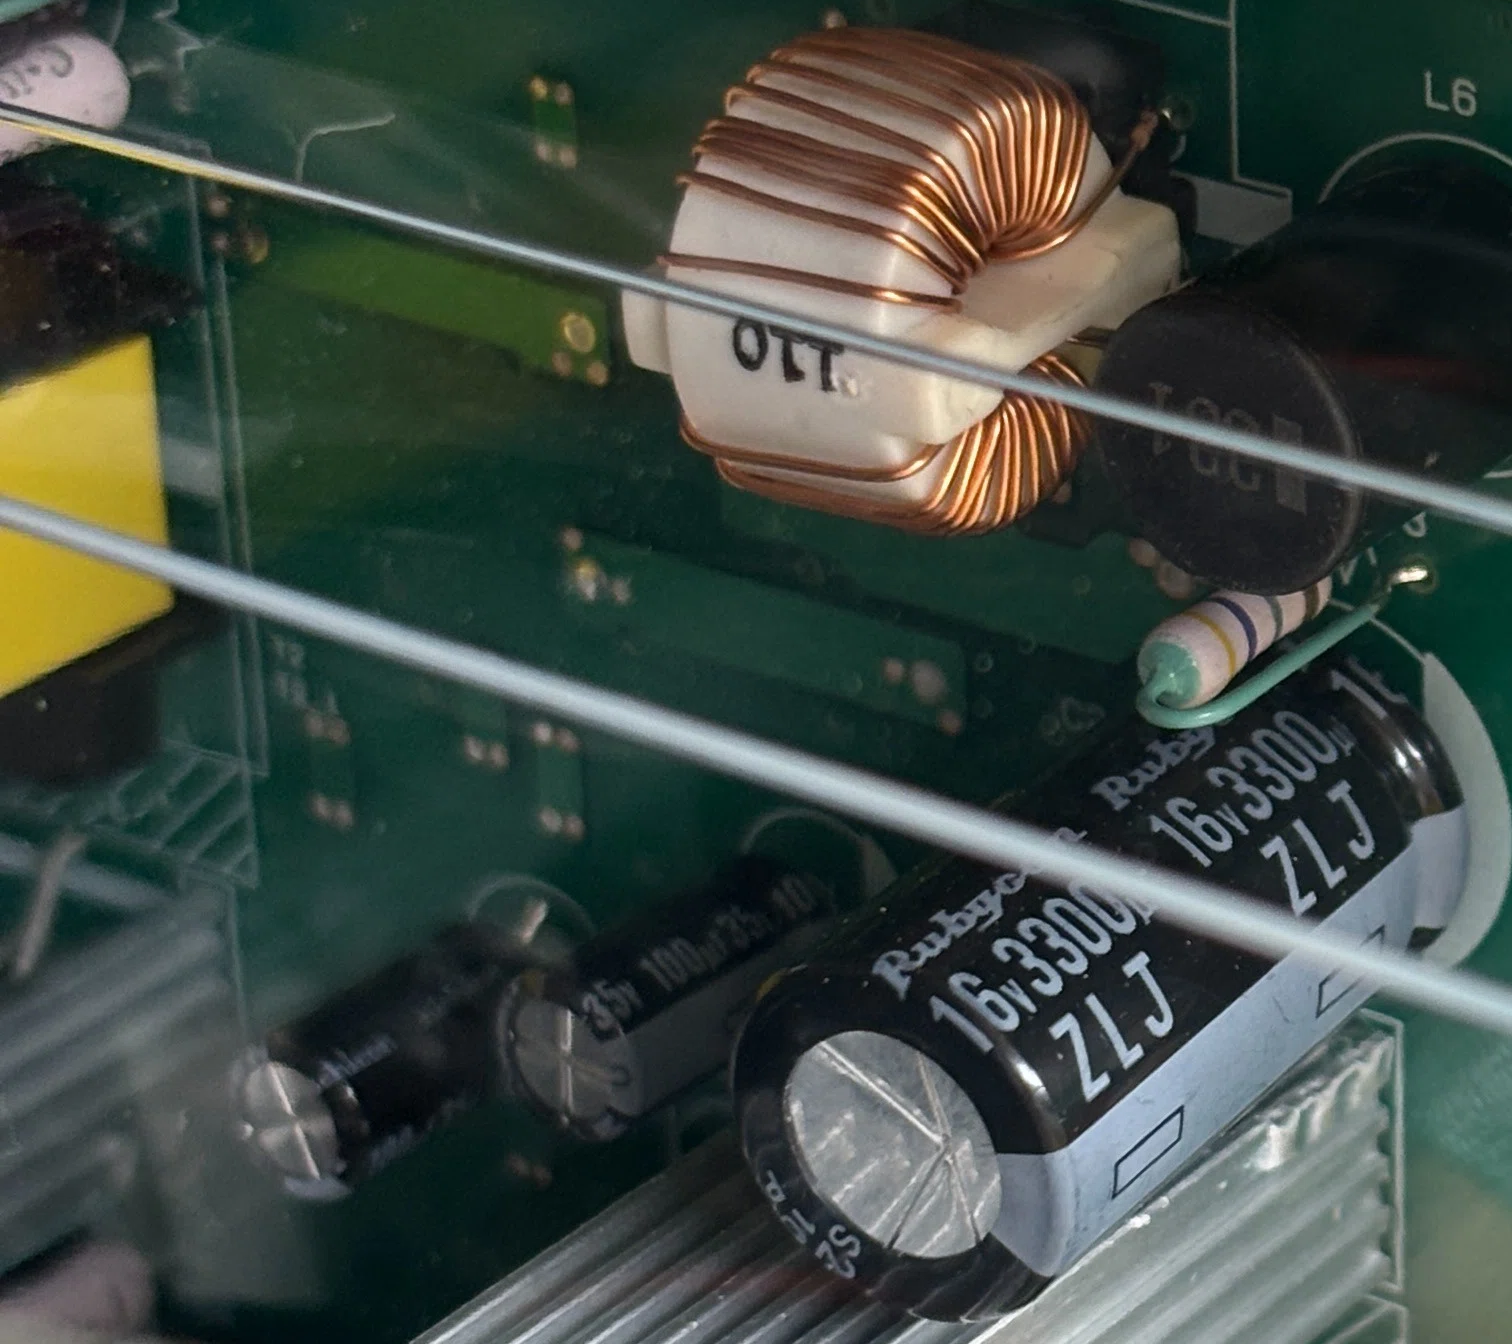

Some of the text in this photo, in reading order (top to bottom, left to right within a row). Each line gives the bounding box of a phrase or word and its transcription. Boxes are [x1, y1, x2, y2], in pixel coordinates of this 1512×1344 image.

[1424, 70, 1479, 117] L6
[1259, 778, 1378, 917] ZLJ
[1050, 951, 1175, 1102] ZLJ
